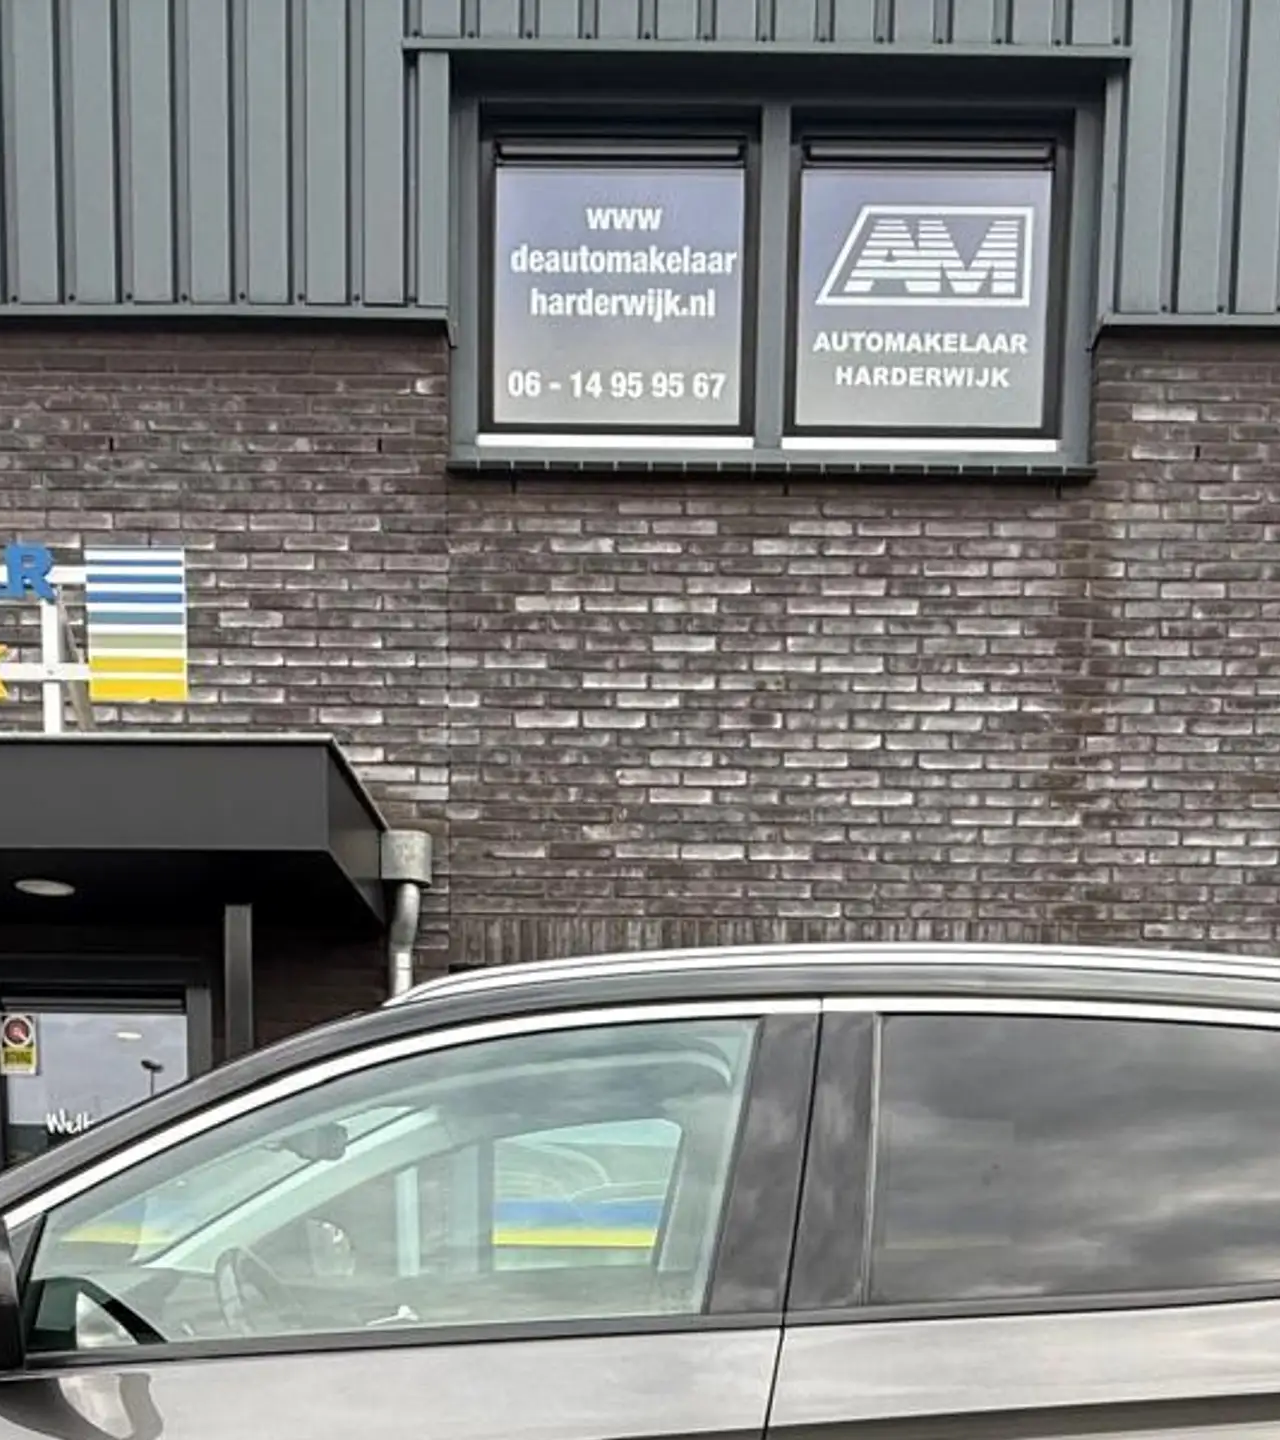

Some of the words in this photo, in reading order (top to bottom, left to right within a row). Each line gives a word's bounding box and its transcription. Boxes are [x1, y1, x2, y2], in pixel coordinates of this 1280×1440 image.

[586, 207, 663, 231] www
[510, 244, 738, 275] deautomakelaar
[843, 218, 1020, 294] AM
[530, 287, 716, 323] harderwijk.nl
[812, 330, 1029, 355] AUTOMAKELAAR
[507, 371, 541, 398] 06
[570, 371, 603, 398] 14
[610, 371, 644, 399] 95
[651, 371, 685, 399] 95
[692, 371, 727, 399] 67
[834, 366, 1011, 389] HARDERWIJK
